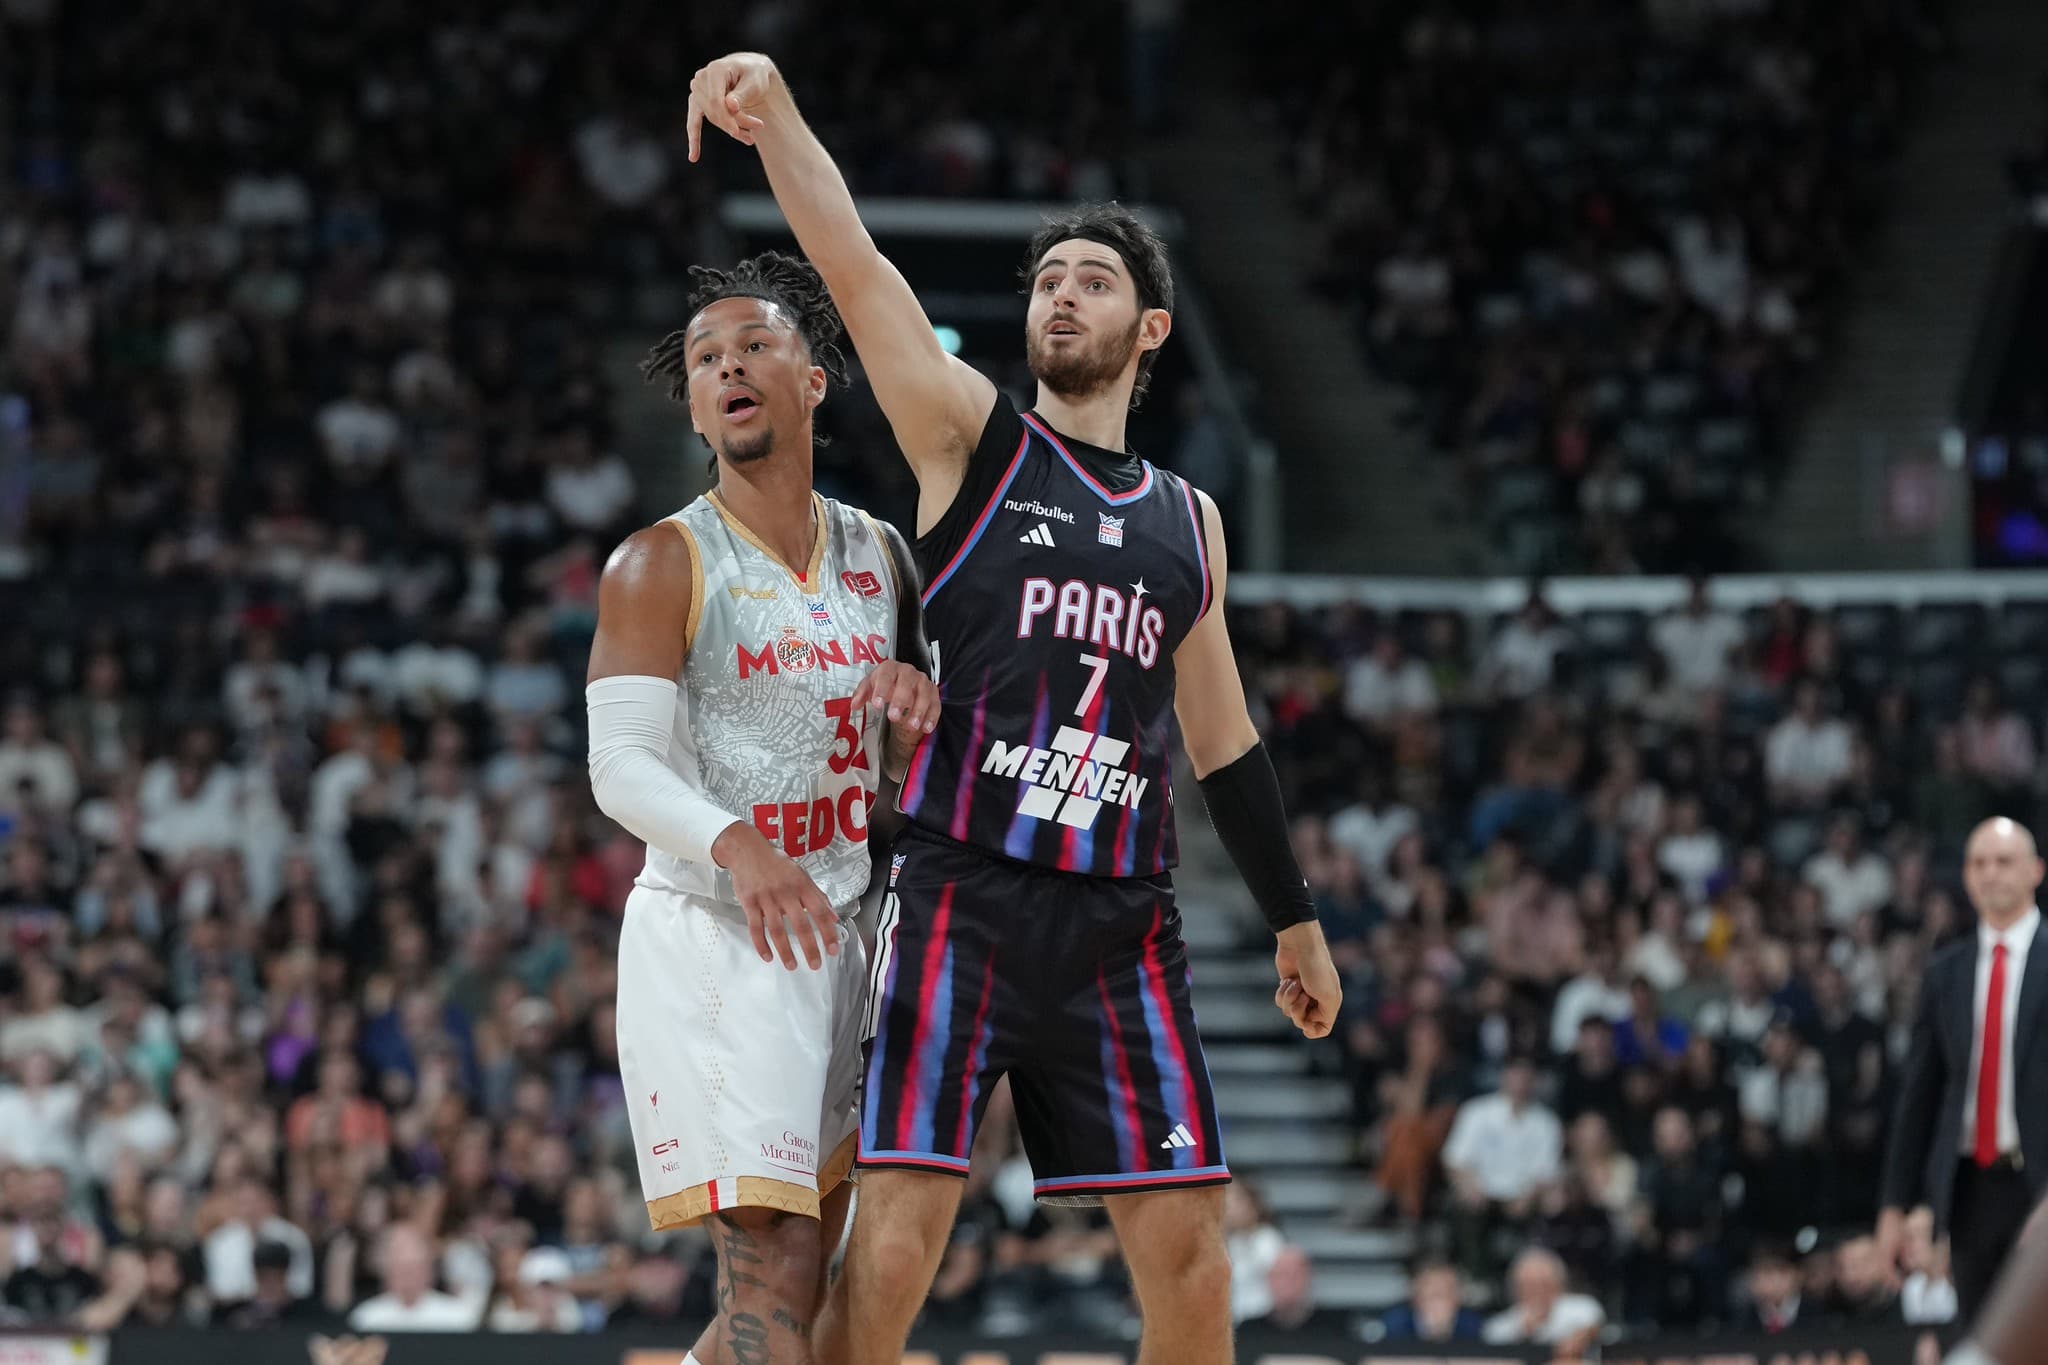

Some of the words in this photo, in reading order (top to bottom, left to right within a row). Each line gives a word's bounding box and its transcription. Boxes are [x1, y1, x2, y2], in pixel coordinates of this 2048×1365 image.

[1099, 534, 1121, 546] ELITE
[1017, 576, 1166, 670] PARIS
[1074, 653, 1109, 717] 7
[981, 740, 1149, 810] MENNEN
[753, 785, 876, 857] FEDC
